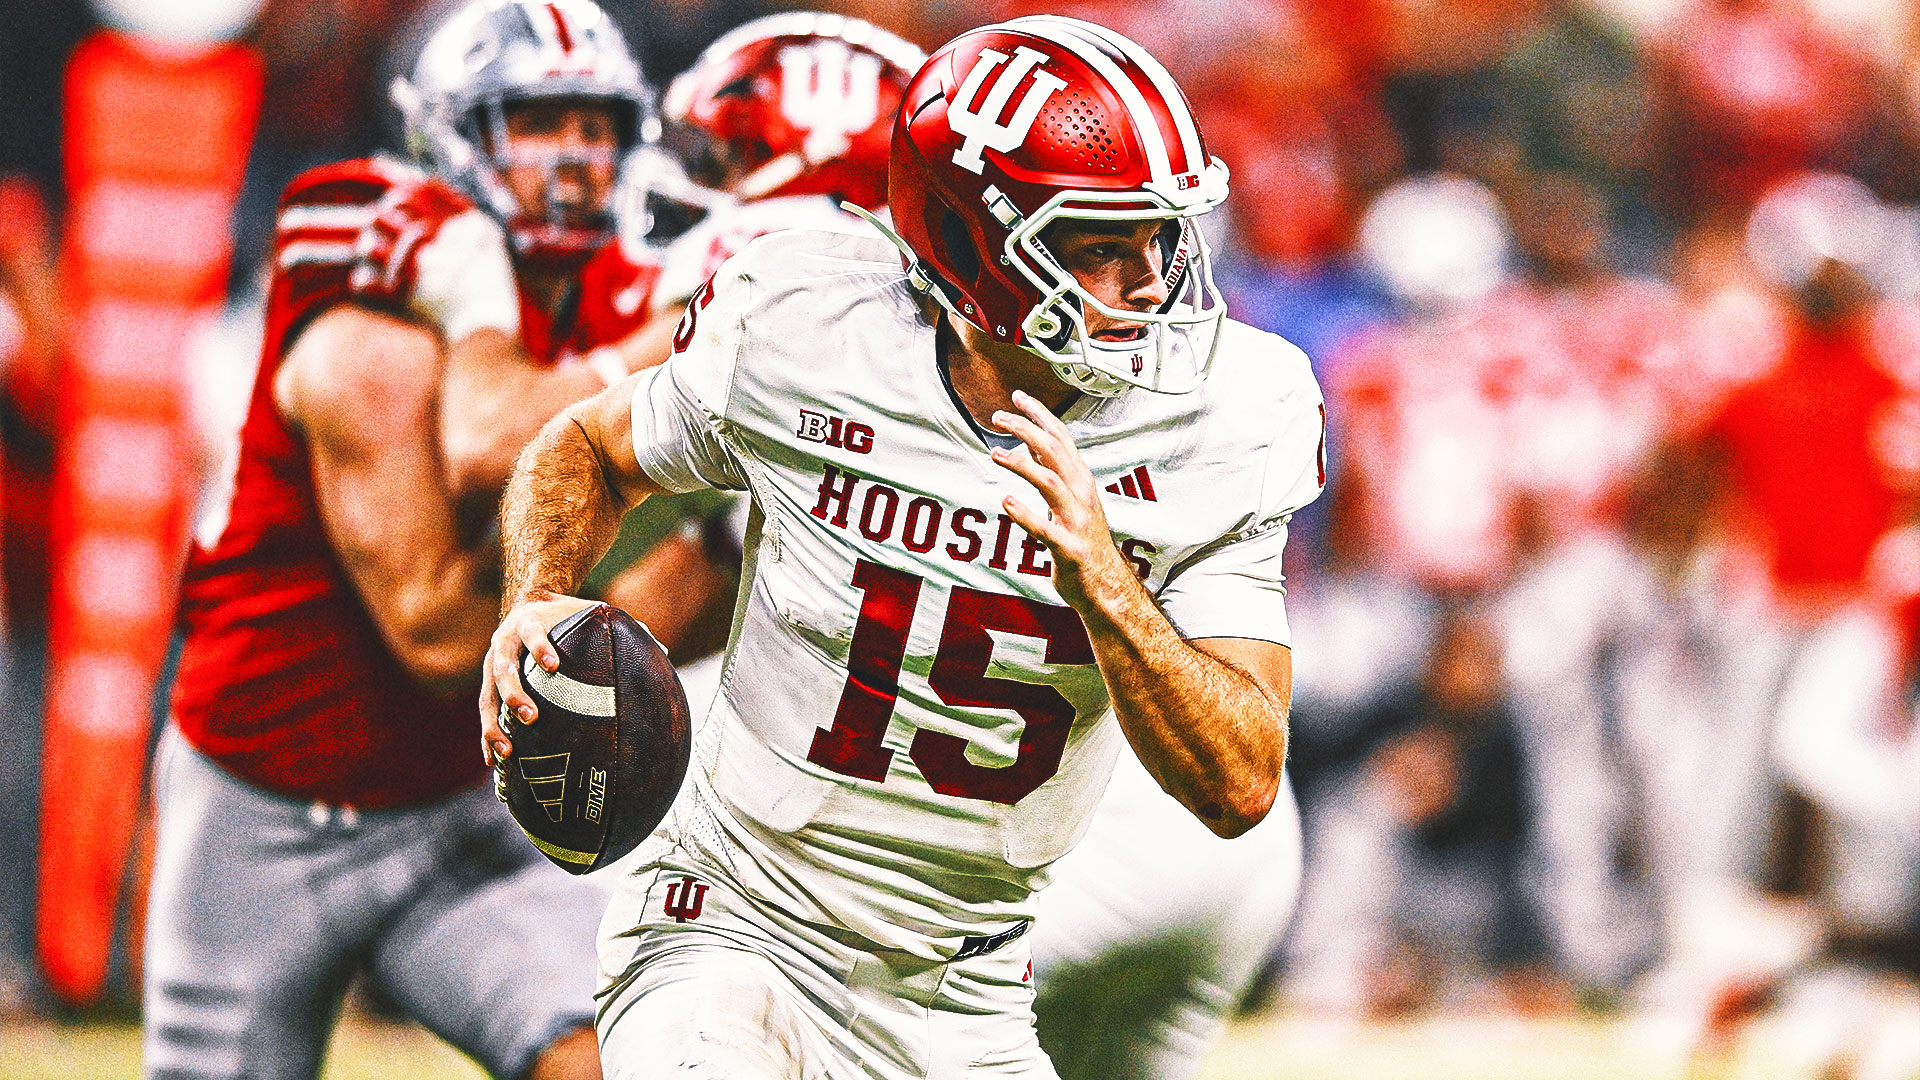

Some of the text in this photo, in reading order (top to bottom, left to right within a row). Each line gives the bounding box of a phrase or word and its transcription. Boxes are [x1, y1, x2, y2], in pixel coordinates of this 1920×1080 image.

[1165, 248, 1188, 293] NDIANA
[811, 462, 1157, 579] HOOSIES
[807, 557, 1096, 804] 15
[585, 766, 606, 824] DIME
